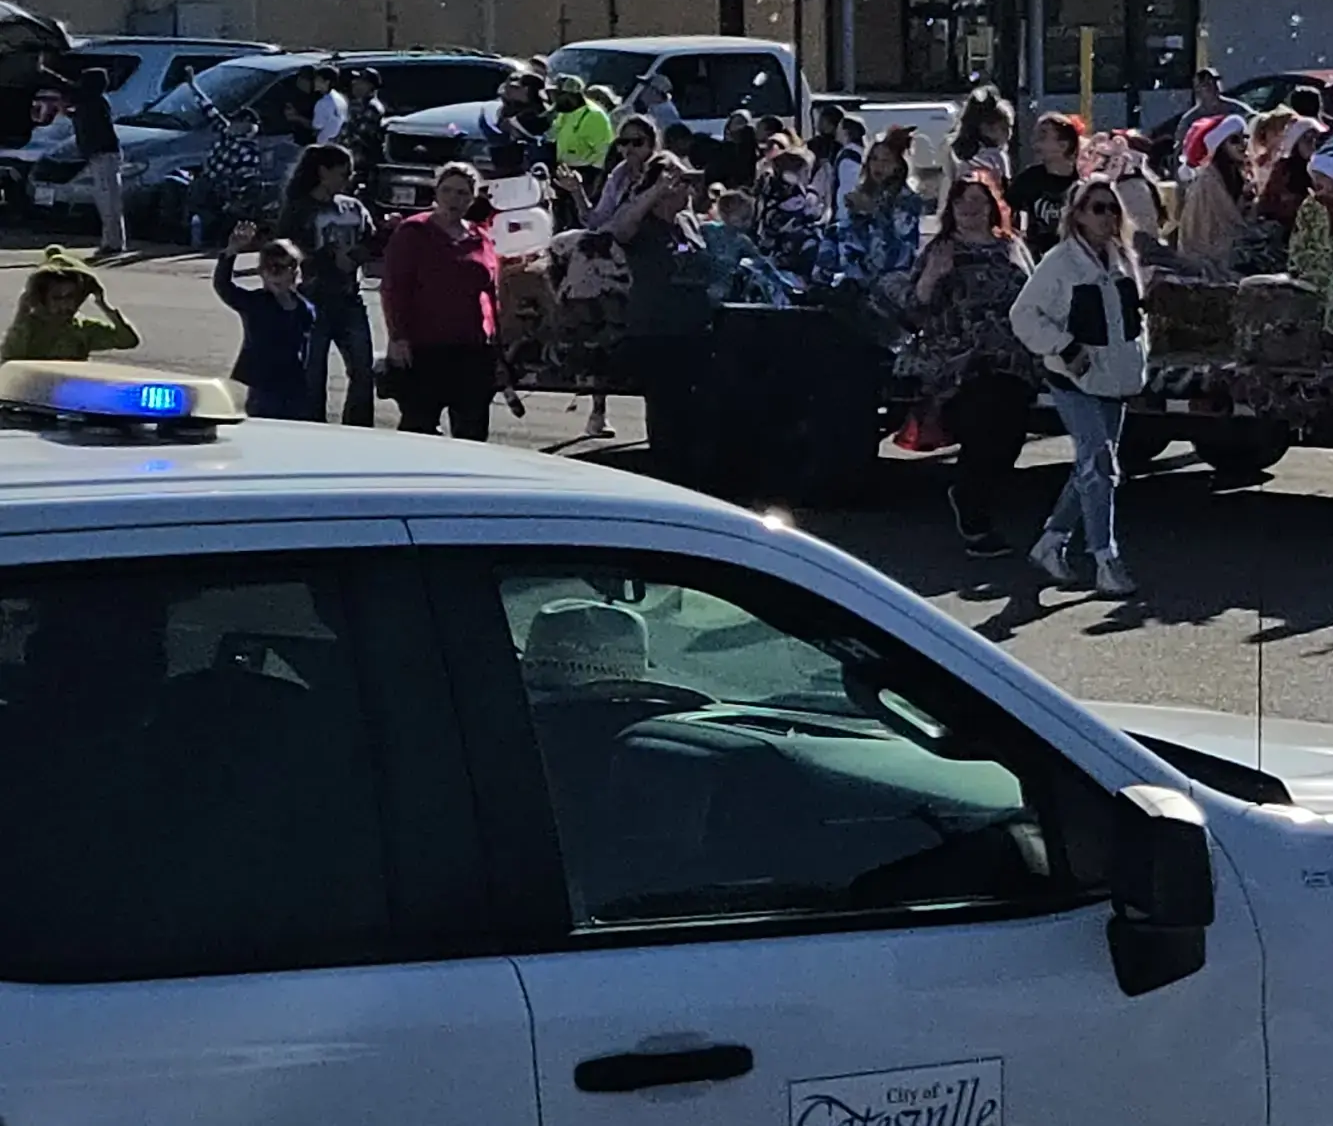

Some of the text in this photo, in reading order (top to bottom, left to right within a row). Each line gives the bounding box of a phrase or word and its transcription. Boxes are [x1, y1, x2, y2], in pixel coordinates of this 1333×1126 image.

[796, 1077, 998, 1126] tesville
[887, 1081, 941, 1106] City of
